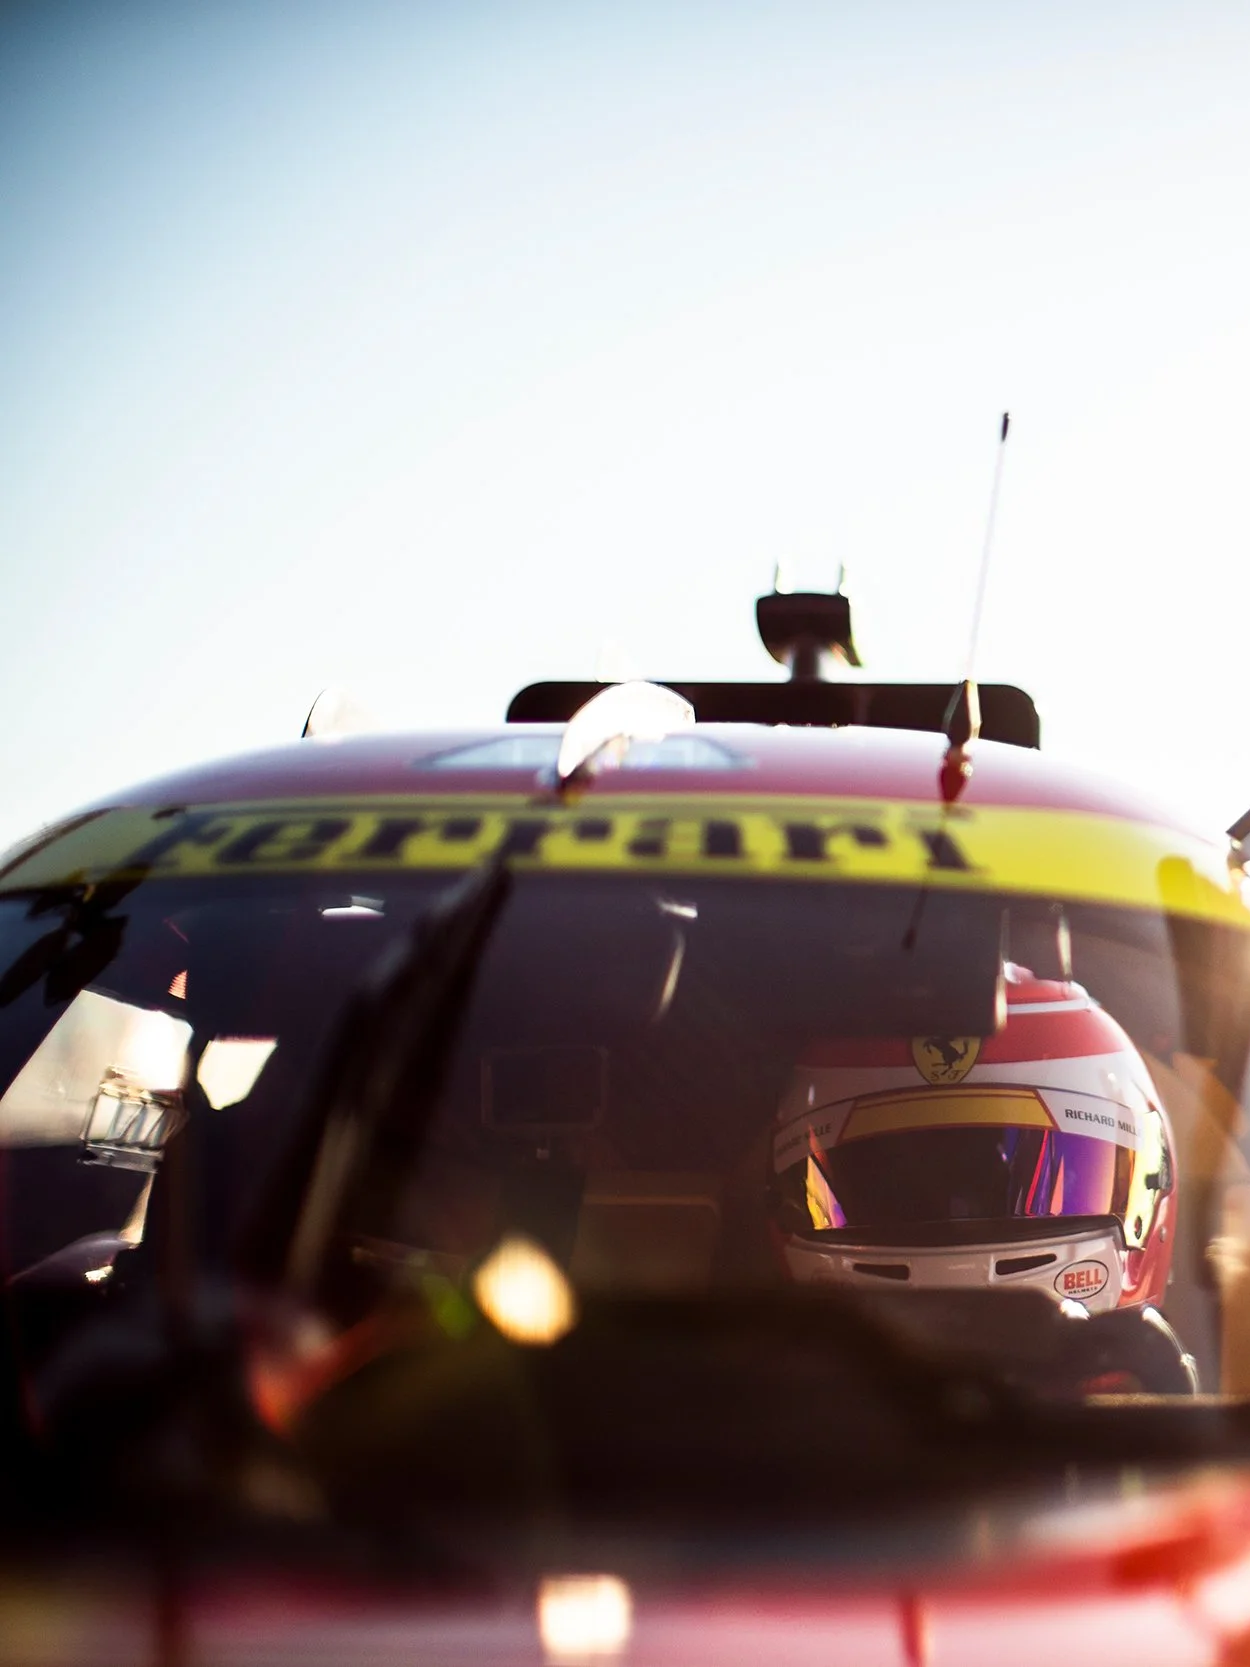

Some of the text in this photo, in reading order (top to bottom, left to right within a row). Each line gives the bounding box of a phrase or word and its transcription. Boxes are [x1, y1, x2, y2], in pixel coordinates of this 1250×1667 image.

[122, 806, 990, 875] Ferrari
[1064, 1108, 1138, 1136] RICHARD MILL
[1063, 1269, 1102, 1290] BELL
